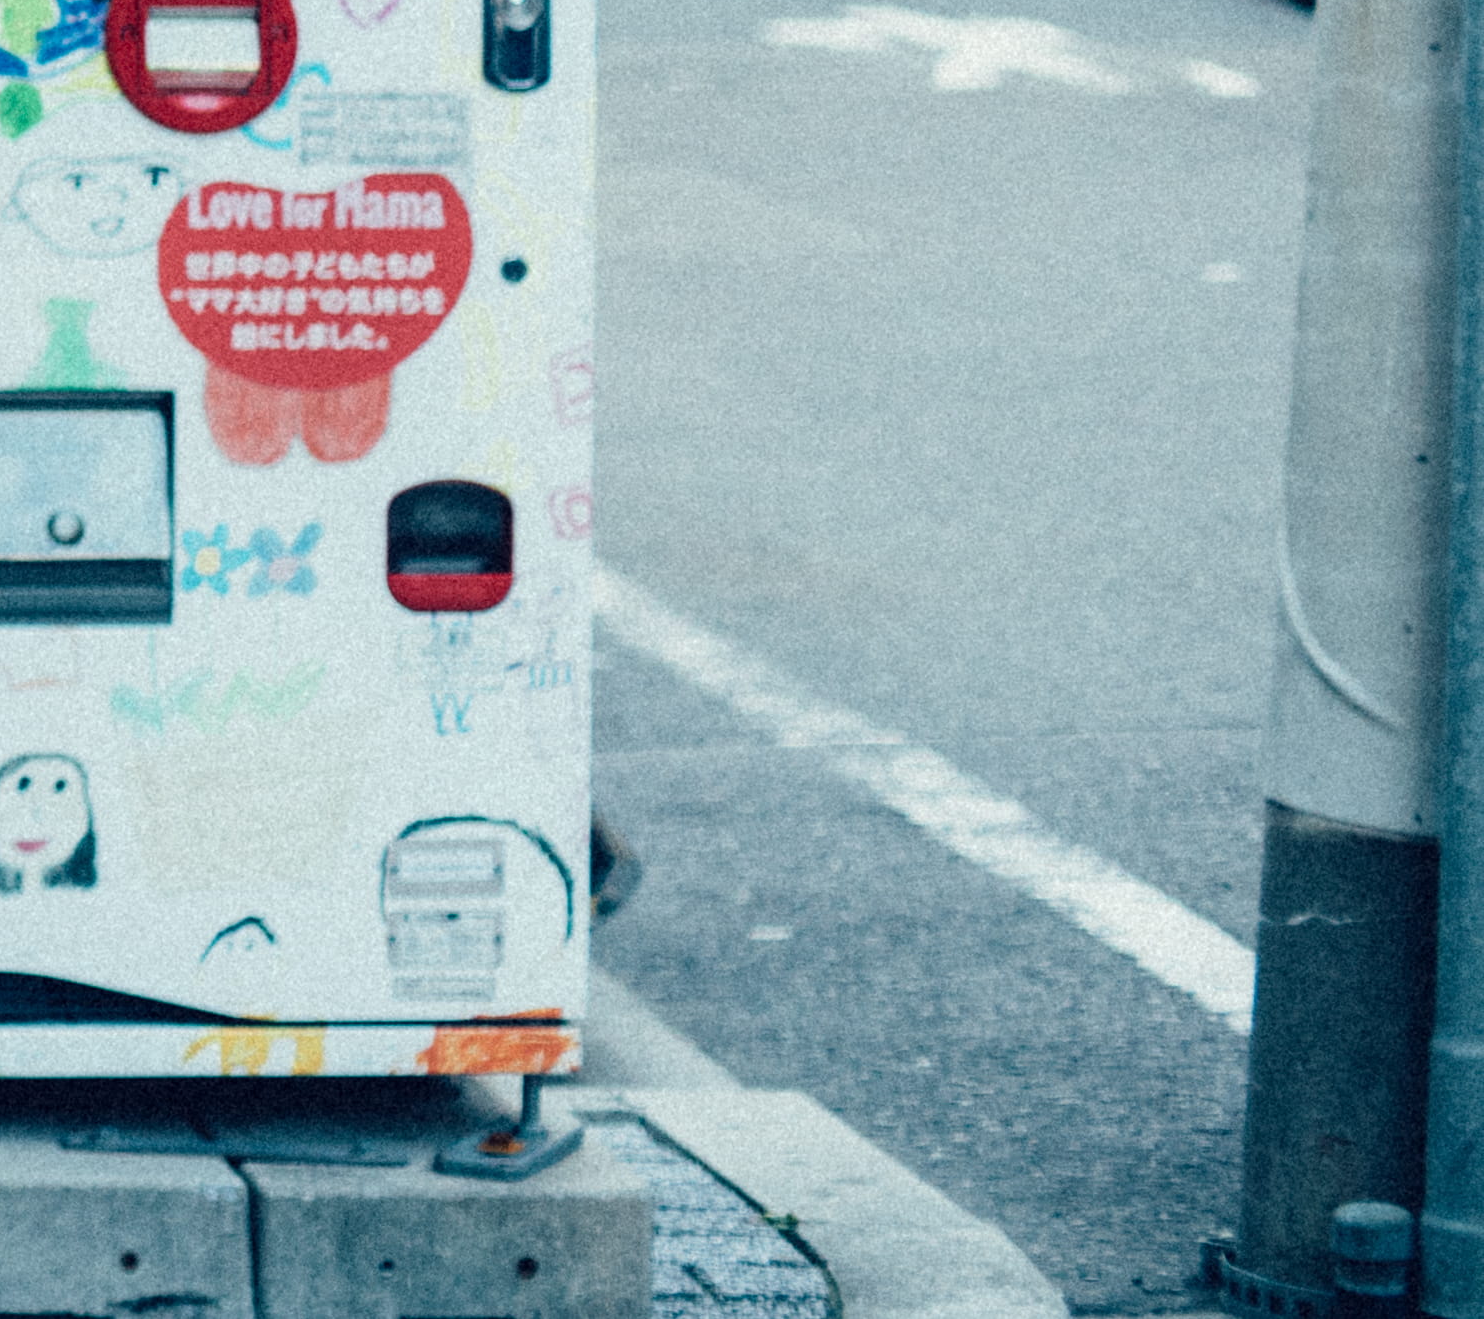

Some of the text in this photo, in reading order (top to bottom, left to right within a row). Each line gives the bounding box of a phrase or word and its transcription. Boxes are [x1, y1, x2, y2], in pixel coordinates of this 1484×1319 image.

[187, 179, 446, 230] Love for Mama
